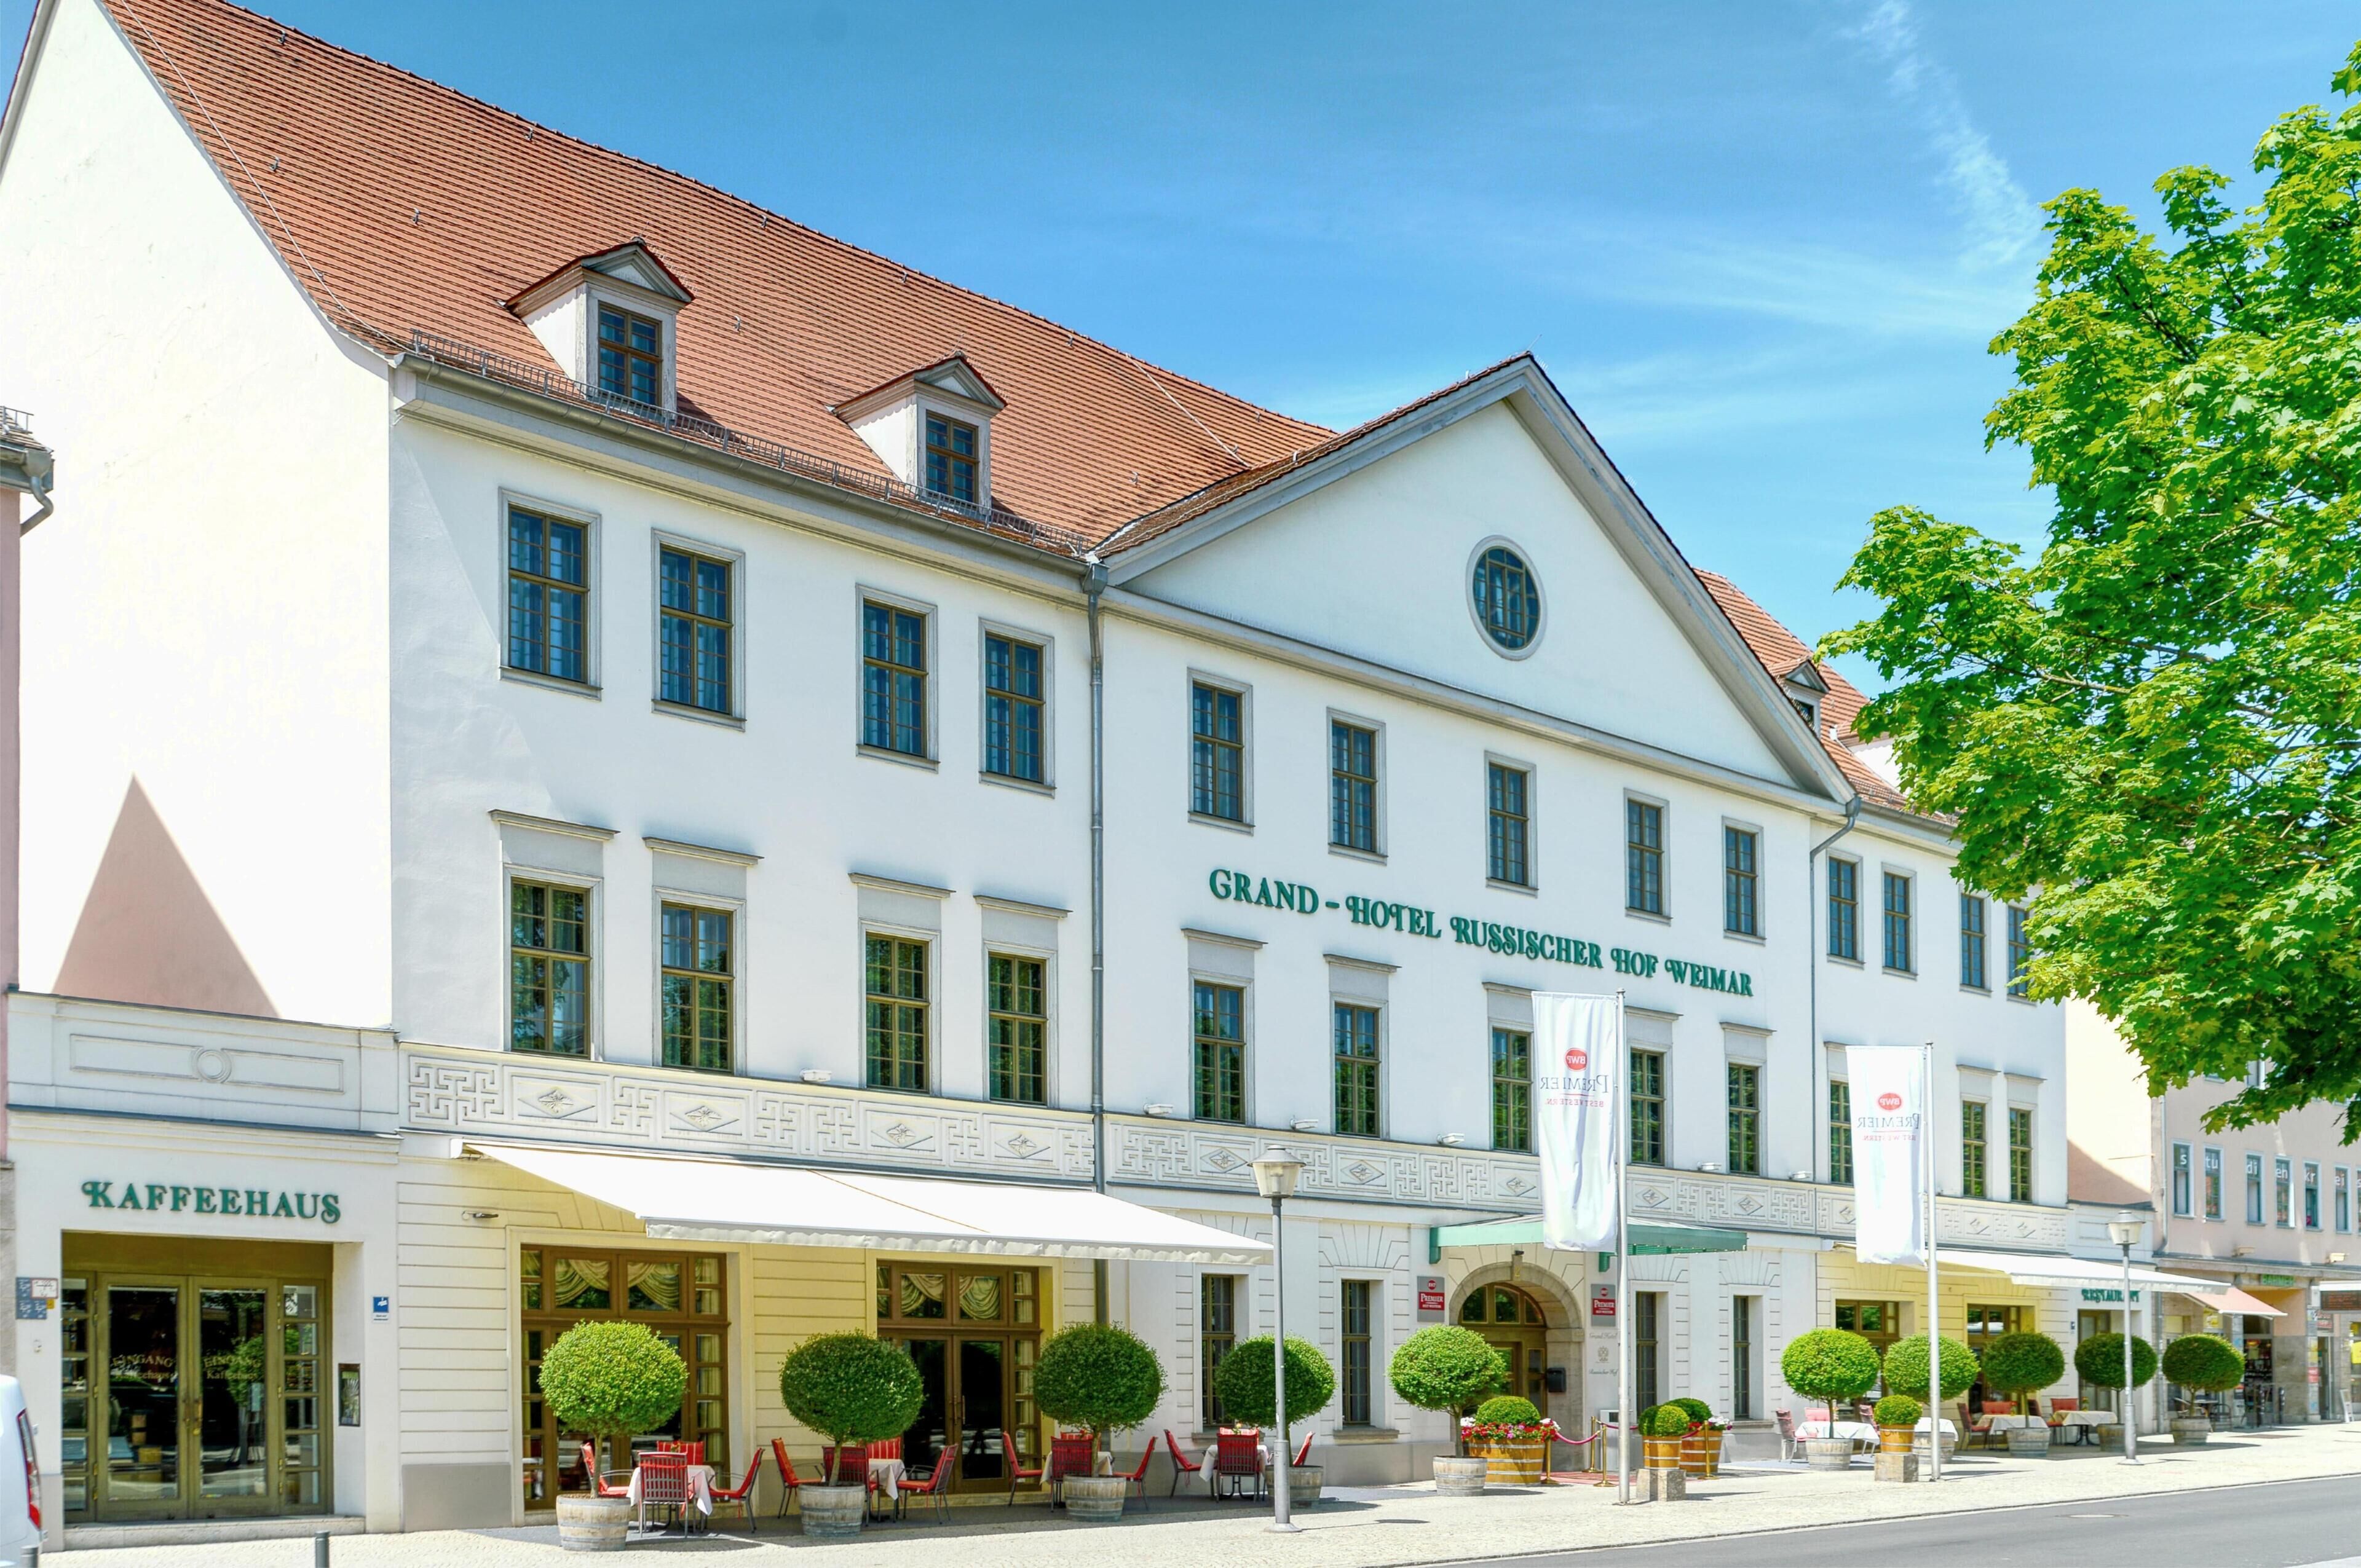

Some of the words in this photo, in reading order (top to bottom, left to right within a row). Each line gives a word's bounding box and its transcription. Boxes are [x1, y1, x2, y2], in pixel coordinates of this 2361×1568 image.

[1209, 869, 1319, 915] GRAND
[1450, 916, 1604, 969] RUSSISCHER
[1611, 947, 1659, 979] HOF
[1664, 959, 1754, 998] WEIMAR
[81, 1181, 341, 1224] KAFFEEHAUS
[1420, 1293, 1444, 1302] PREMIER
[2081, 1288, 2141, 1304] RESTAURNT
